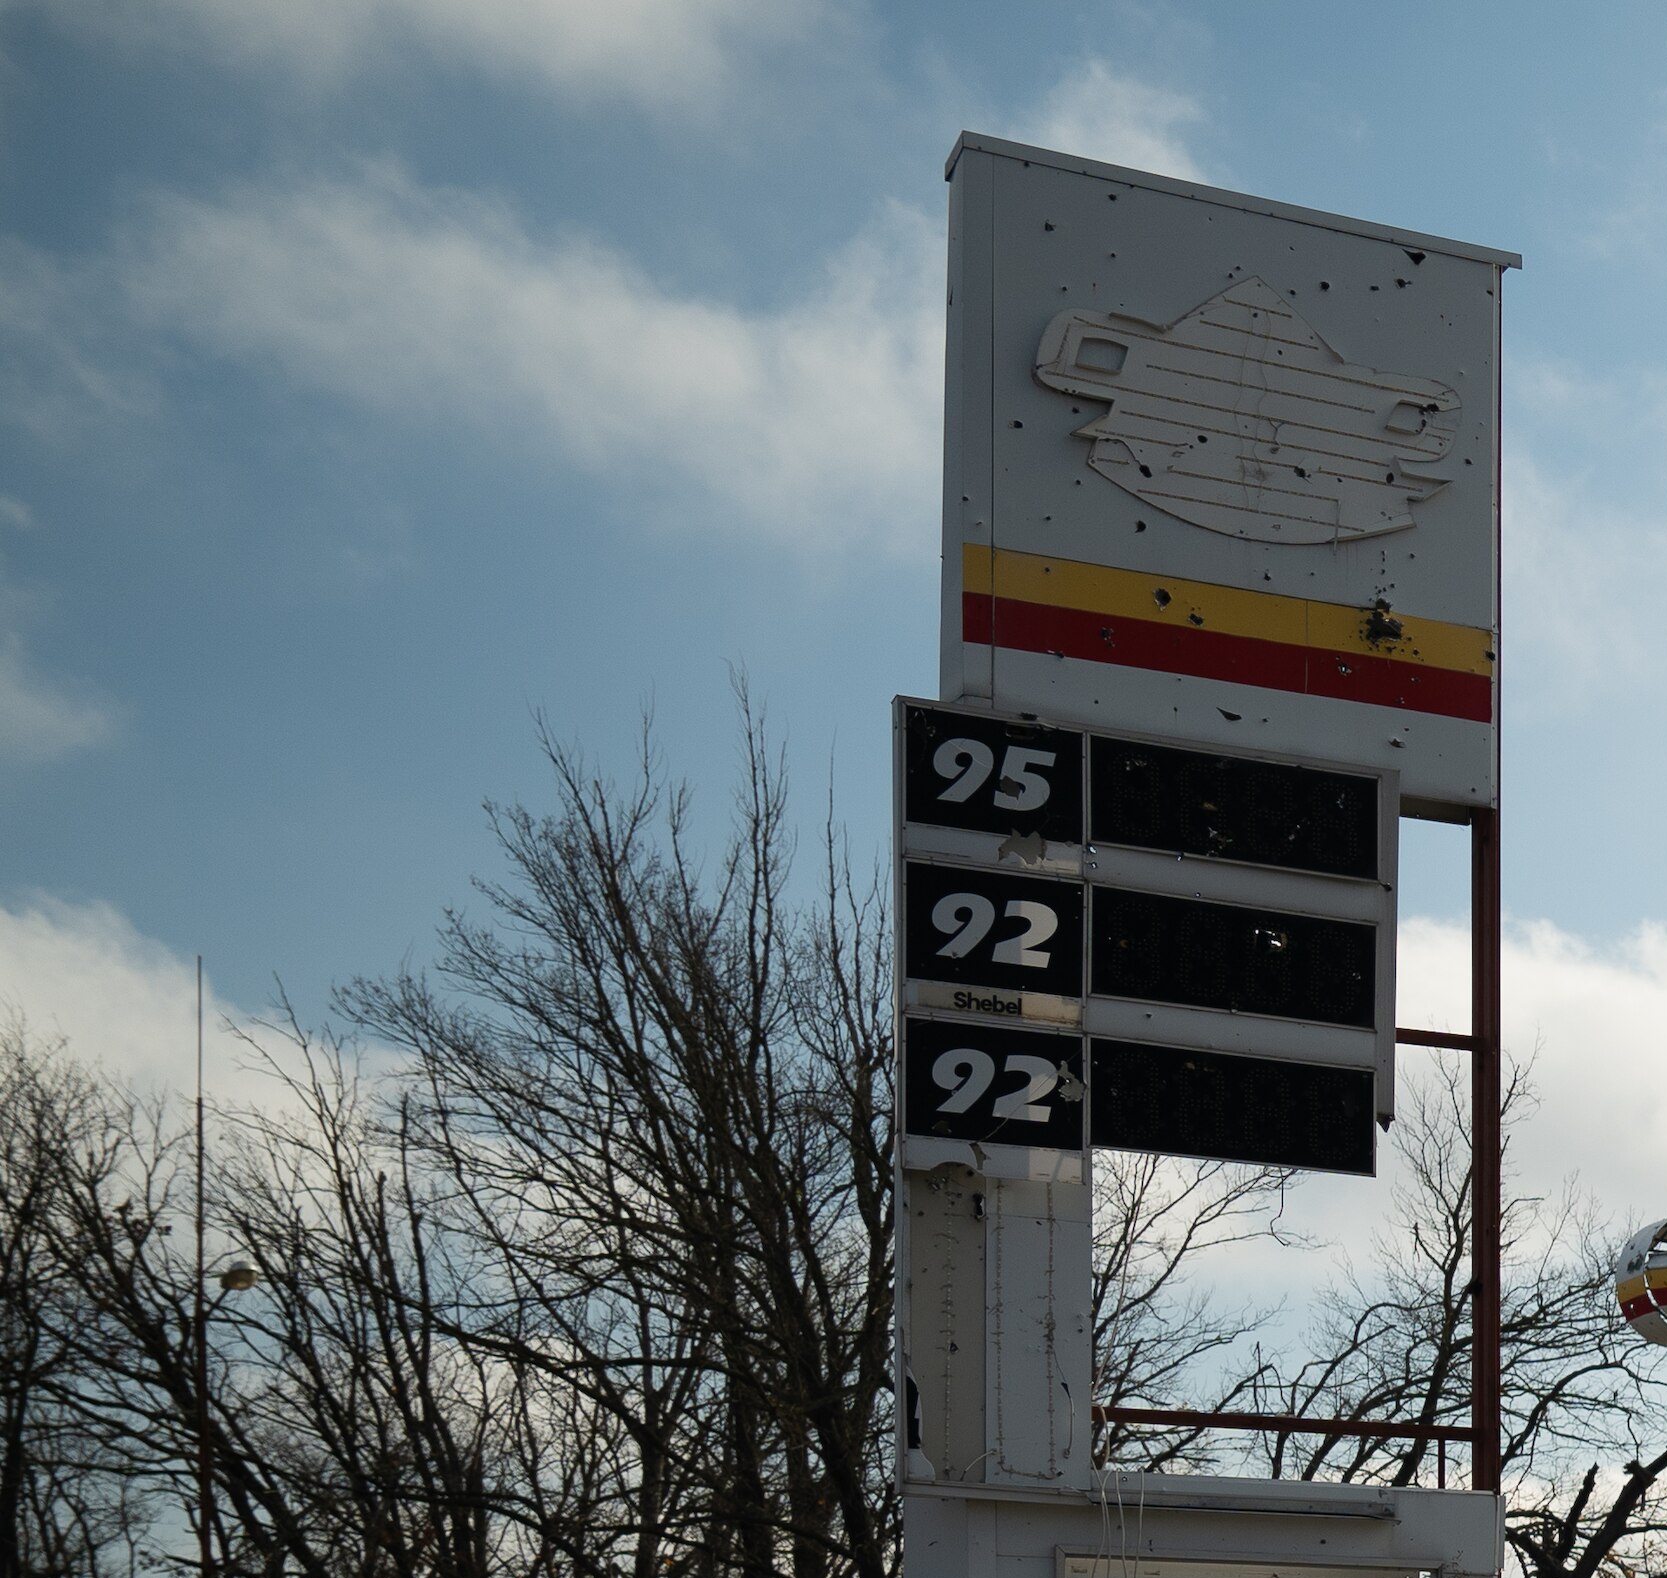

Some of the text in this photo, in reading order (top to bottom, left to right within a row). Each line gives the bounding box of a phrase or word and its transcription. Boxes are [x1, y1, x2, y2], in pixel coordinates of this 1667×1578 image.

[932, 737, 1056, 812] 95
[931, 892, 1059, 969] 92
[953, 991, 1023, 1016] Shebel
[931, 1047, 1058, 1123] 92
